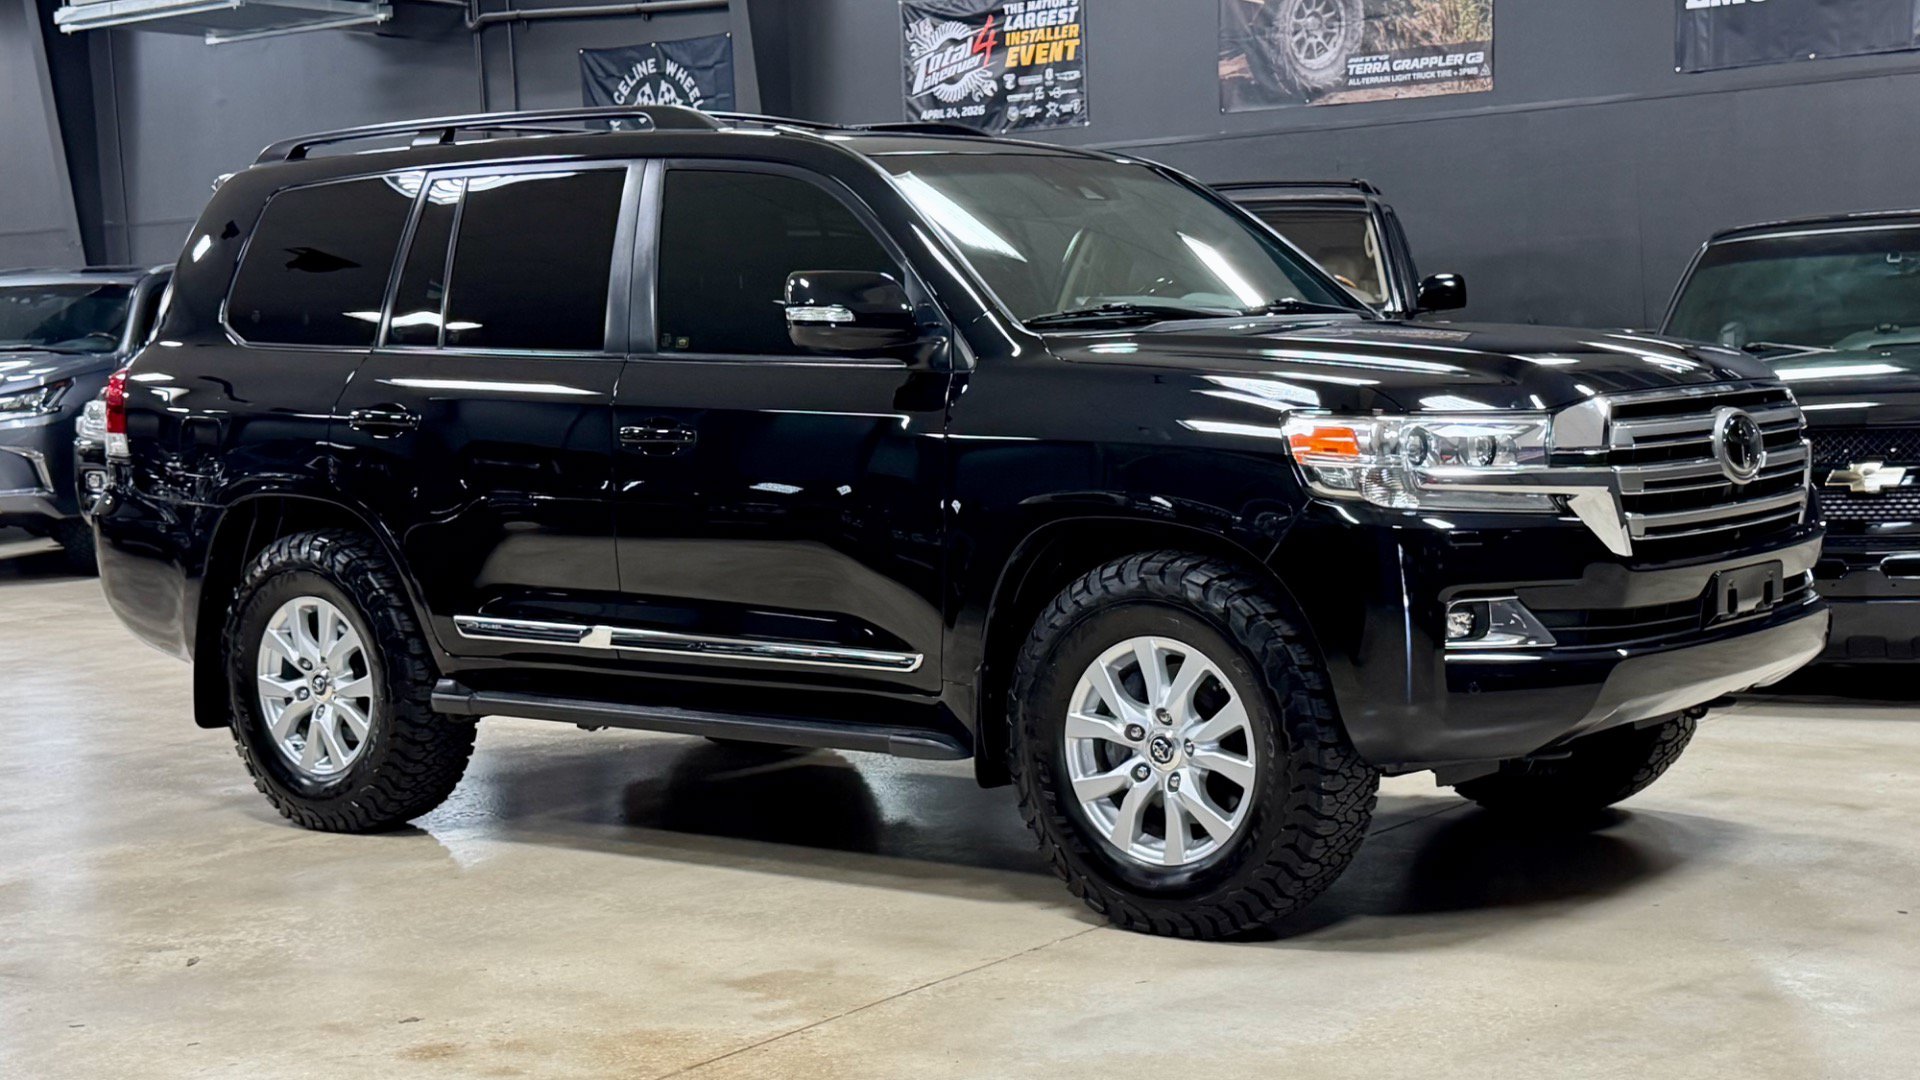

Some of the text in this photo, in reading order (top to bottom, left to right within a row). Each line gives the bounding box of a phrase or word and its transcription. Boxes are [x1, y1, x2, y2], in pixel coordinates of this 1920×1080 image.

[1003, 2, 1025, 15] THE
[1003, 6, 1079, 31] LARGEST
[1005, 24, 1080, 46] INSTALLER
[912, 14, 997, 95] Total 4
[1005, 38, 1080, 68] EVENT
[1347, 51, 1484, 75] TERRA GRAPPLER G3
[613, 57, 657, 105] CELINE
[1348, 76, 1391, 86] ALL-TERRAIN
[1391, 73, 1412, 82] LIGHT
[1412, 70, 1436, 80] TRUCK
[1436, 69, 1452, 78] TIRE
[920, 108, 945, 120] APRIL
